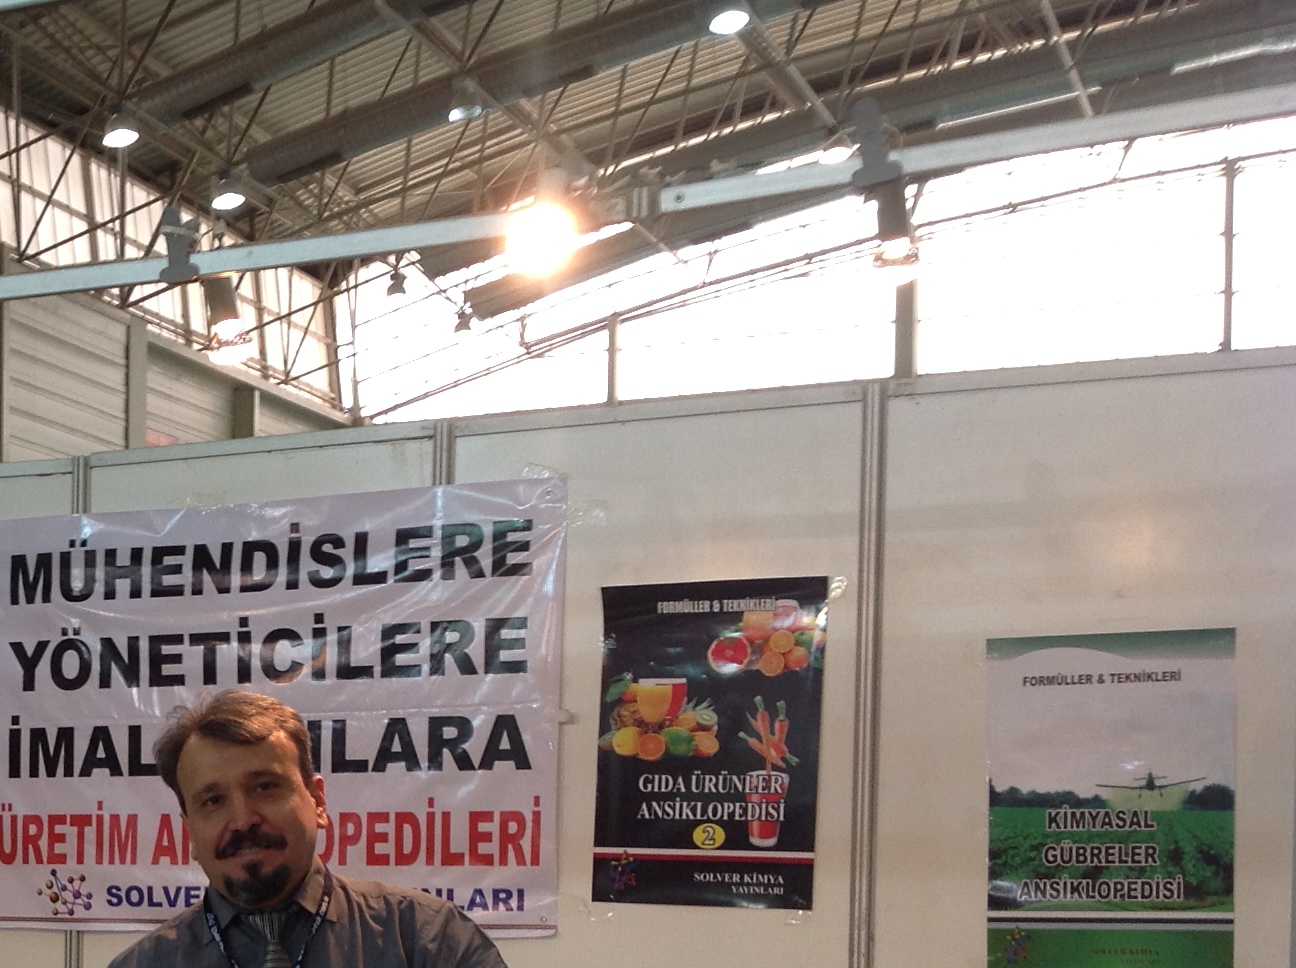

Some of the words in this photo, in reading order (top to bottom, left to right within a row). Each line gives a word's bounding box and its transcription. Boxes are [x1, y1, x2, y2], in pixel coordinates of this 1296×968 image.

[9, 519, 534, 606] MÜHENDİSLERE
[657, 599, 710, 613] FORMÜLLER
[713, 600, 720, 612] &
[723, 596, 776, 612] TEKNİKLERİ
[9, 612, 529, 692] YÖNETİCİLERE
[1022, 673, 1093, 688] FORMÜLLER
[1097, 674, 1105, 684] &
[1110, 668, 1182, 684] TEKNİKLERİ
[8, 714, 532, 778] İMALILARA
[638, 773, 686, 793] GIDA
[691, 770, 783, 794] ÜRÜNLER
[637, 797, 785, 821] ANSİKLOPEDİSİ
[1046, 805, 1156, 831] KİMYASAL
[702, 826, 716, 845] 2
[1043, 840, 1159, 867] GÜBRELER
[693, 872, 740, 883] SOLVER
[743, 871, 784, 884] KİMYA
[1018, 875, 1184, 901] ANSİKLOPEDİSİ
[106, 885, 209, 908] SOLVE
[731, 885, 784, 895] YAYINLARI
